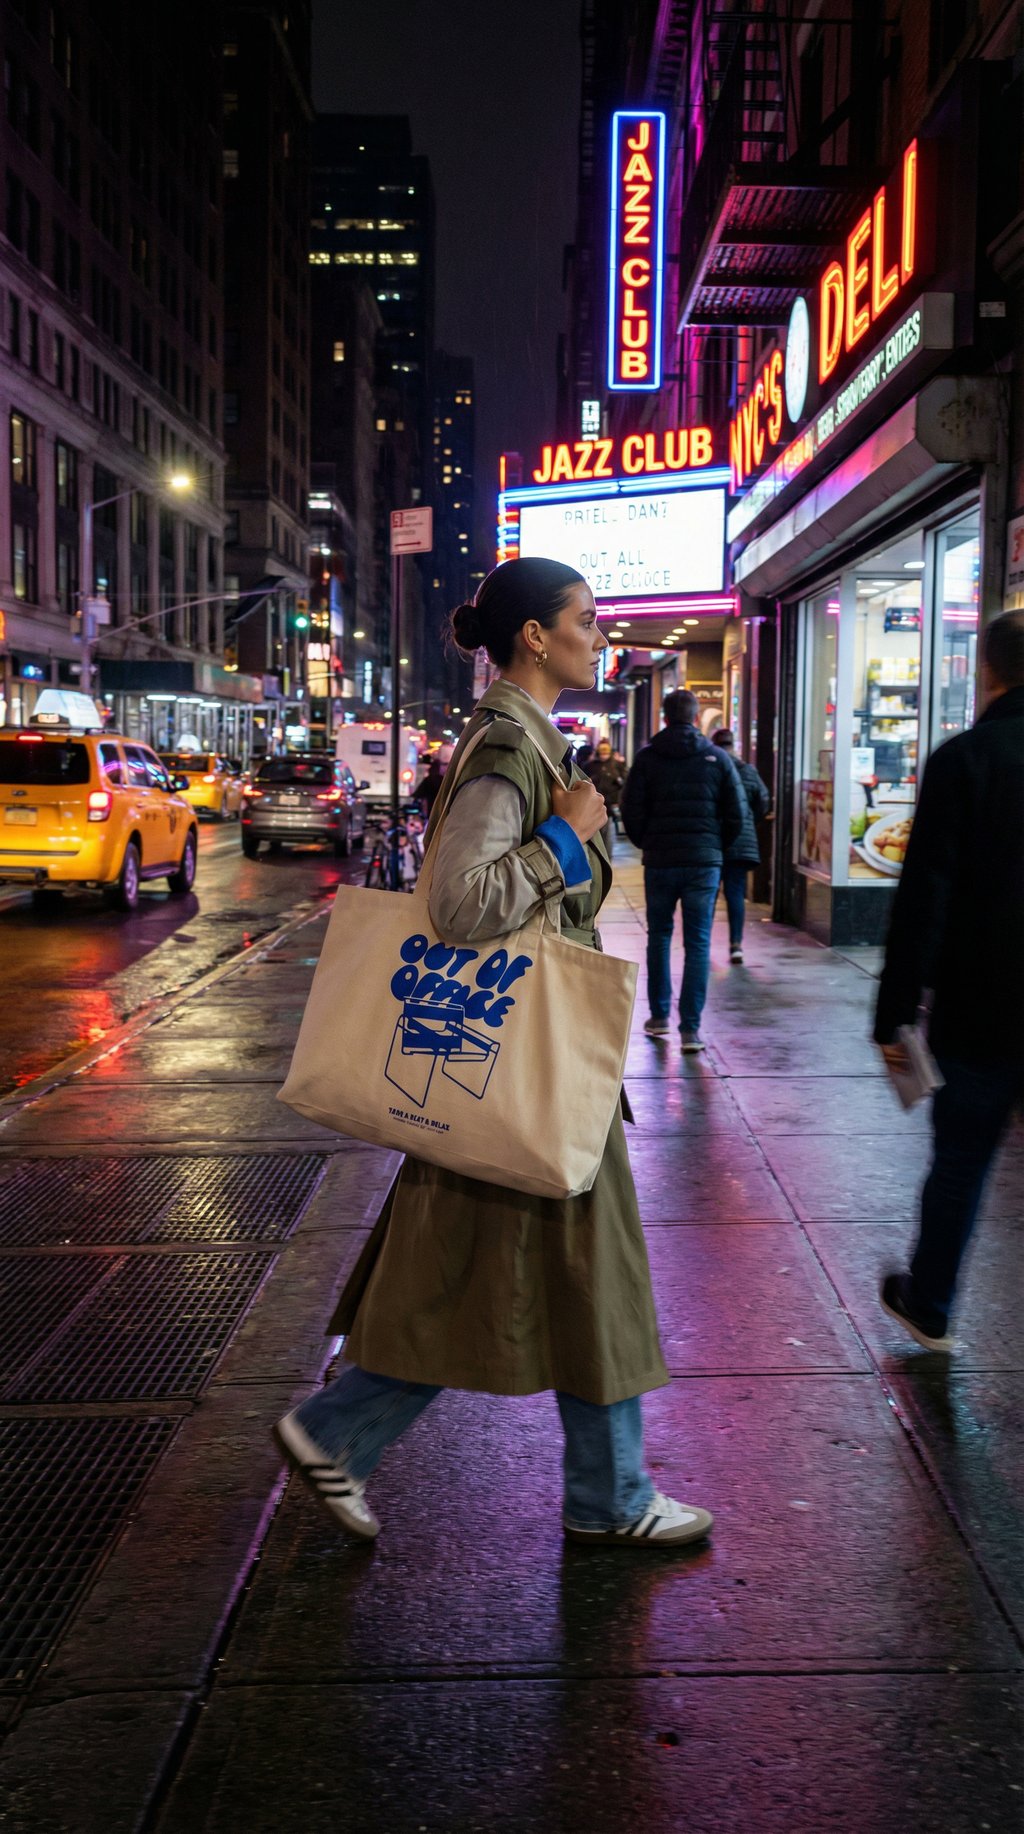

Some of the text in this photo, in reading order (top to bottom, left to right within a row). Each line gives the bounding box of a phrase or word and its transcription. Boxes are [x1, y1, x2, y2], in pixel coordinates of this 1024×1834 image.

[620, 121, 653, 379] JAZZ CLUB
[730, 349, 783, 495] NYC'S
[818, 138, 917, 385] DELI
[533, 426, 713, 484] JAZZ CLUB
[579, 550, 645, 569] OUT ALL
[400, 933, 533, 994] OUT OF
[390, 964, 516, 1028] OFFICE
